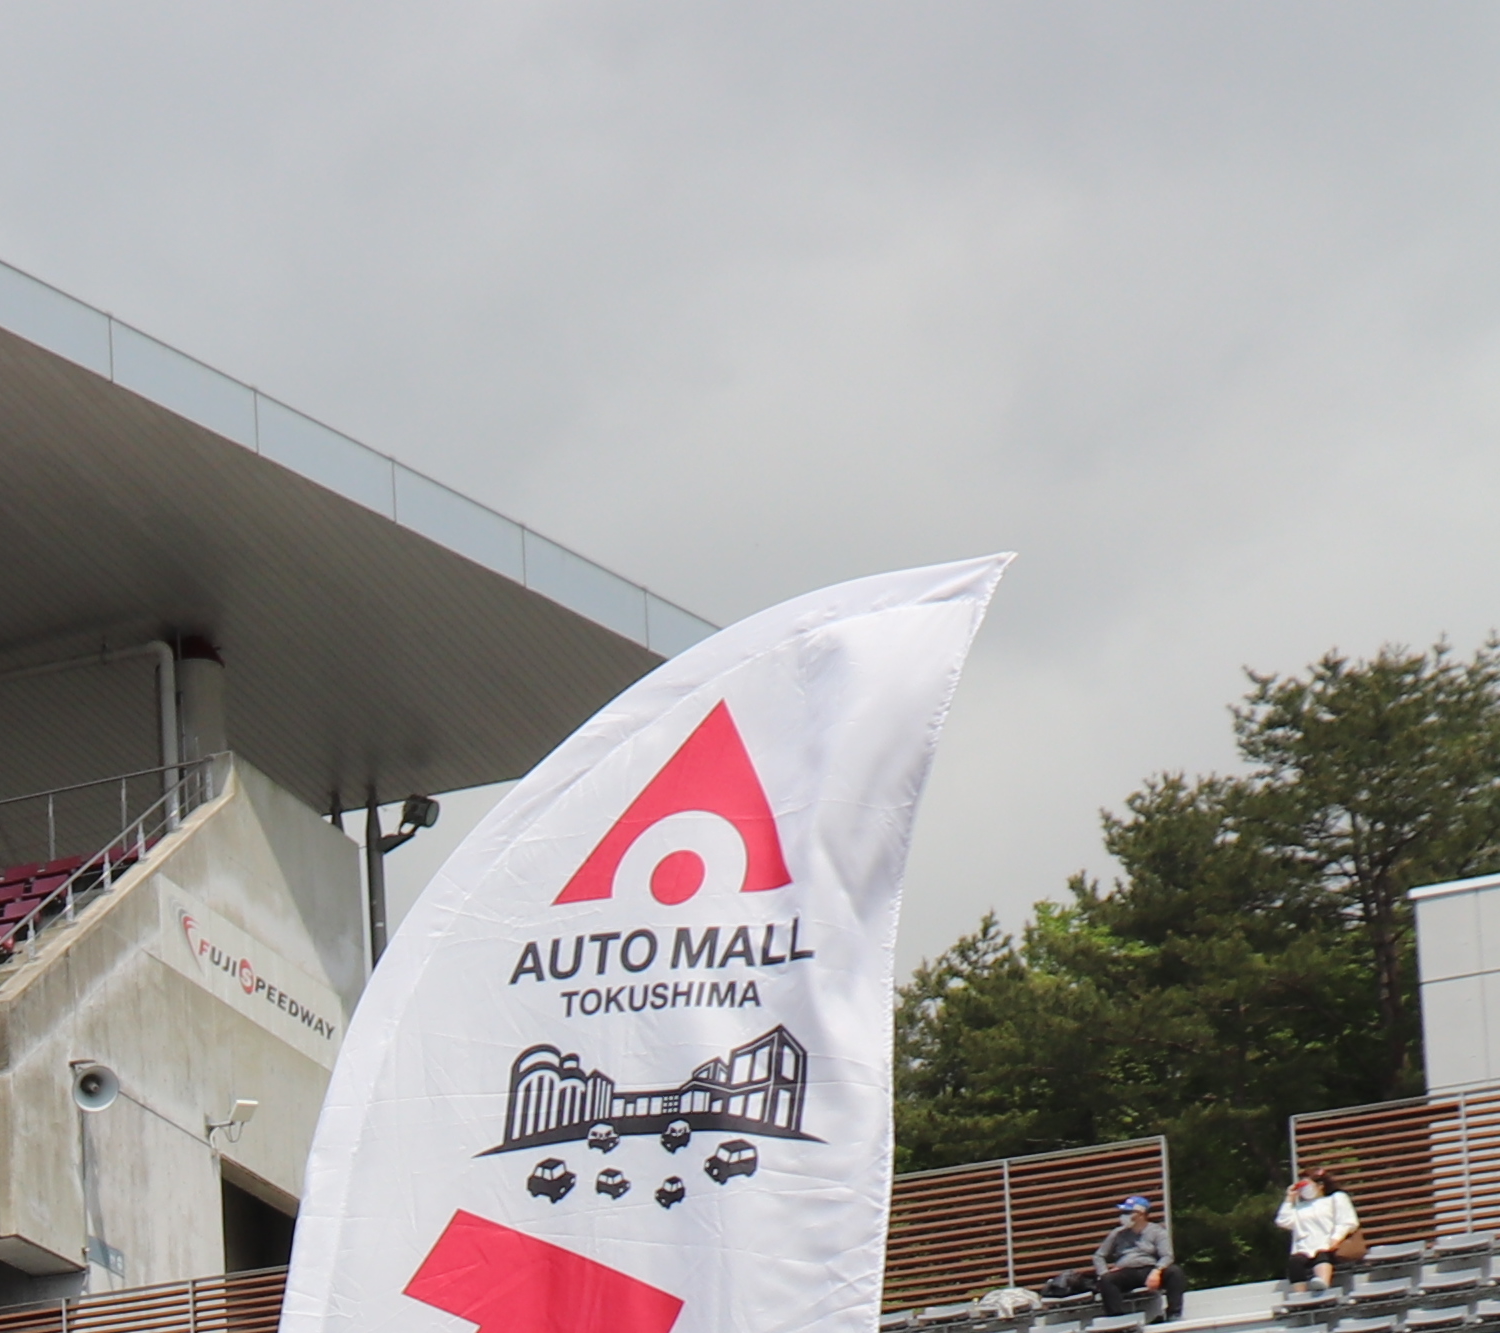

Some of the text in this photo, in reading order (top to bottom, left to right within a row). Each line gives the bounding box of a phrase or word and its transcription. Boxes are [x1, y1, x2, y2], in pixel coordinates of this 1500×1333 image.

[509, 917, 815, 984] AUTO MALL
[199, 939, 336, 1041] FUJI SPEEDWAY
[560, 980, 761, 1018] TOKUSHIMA
